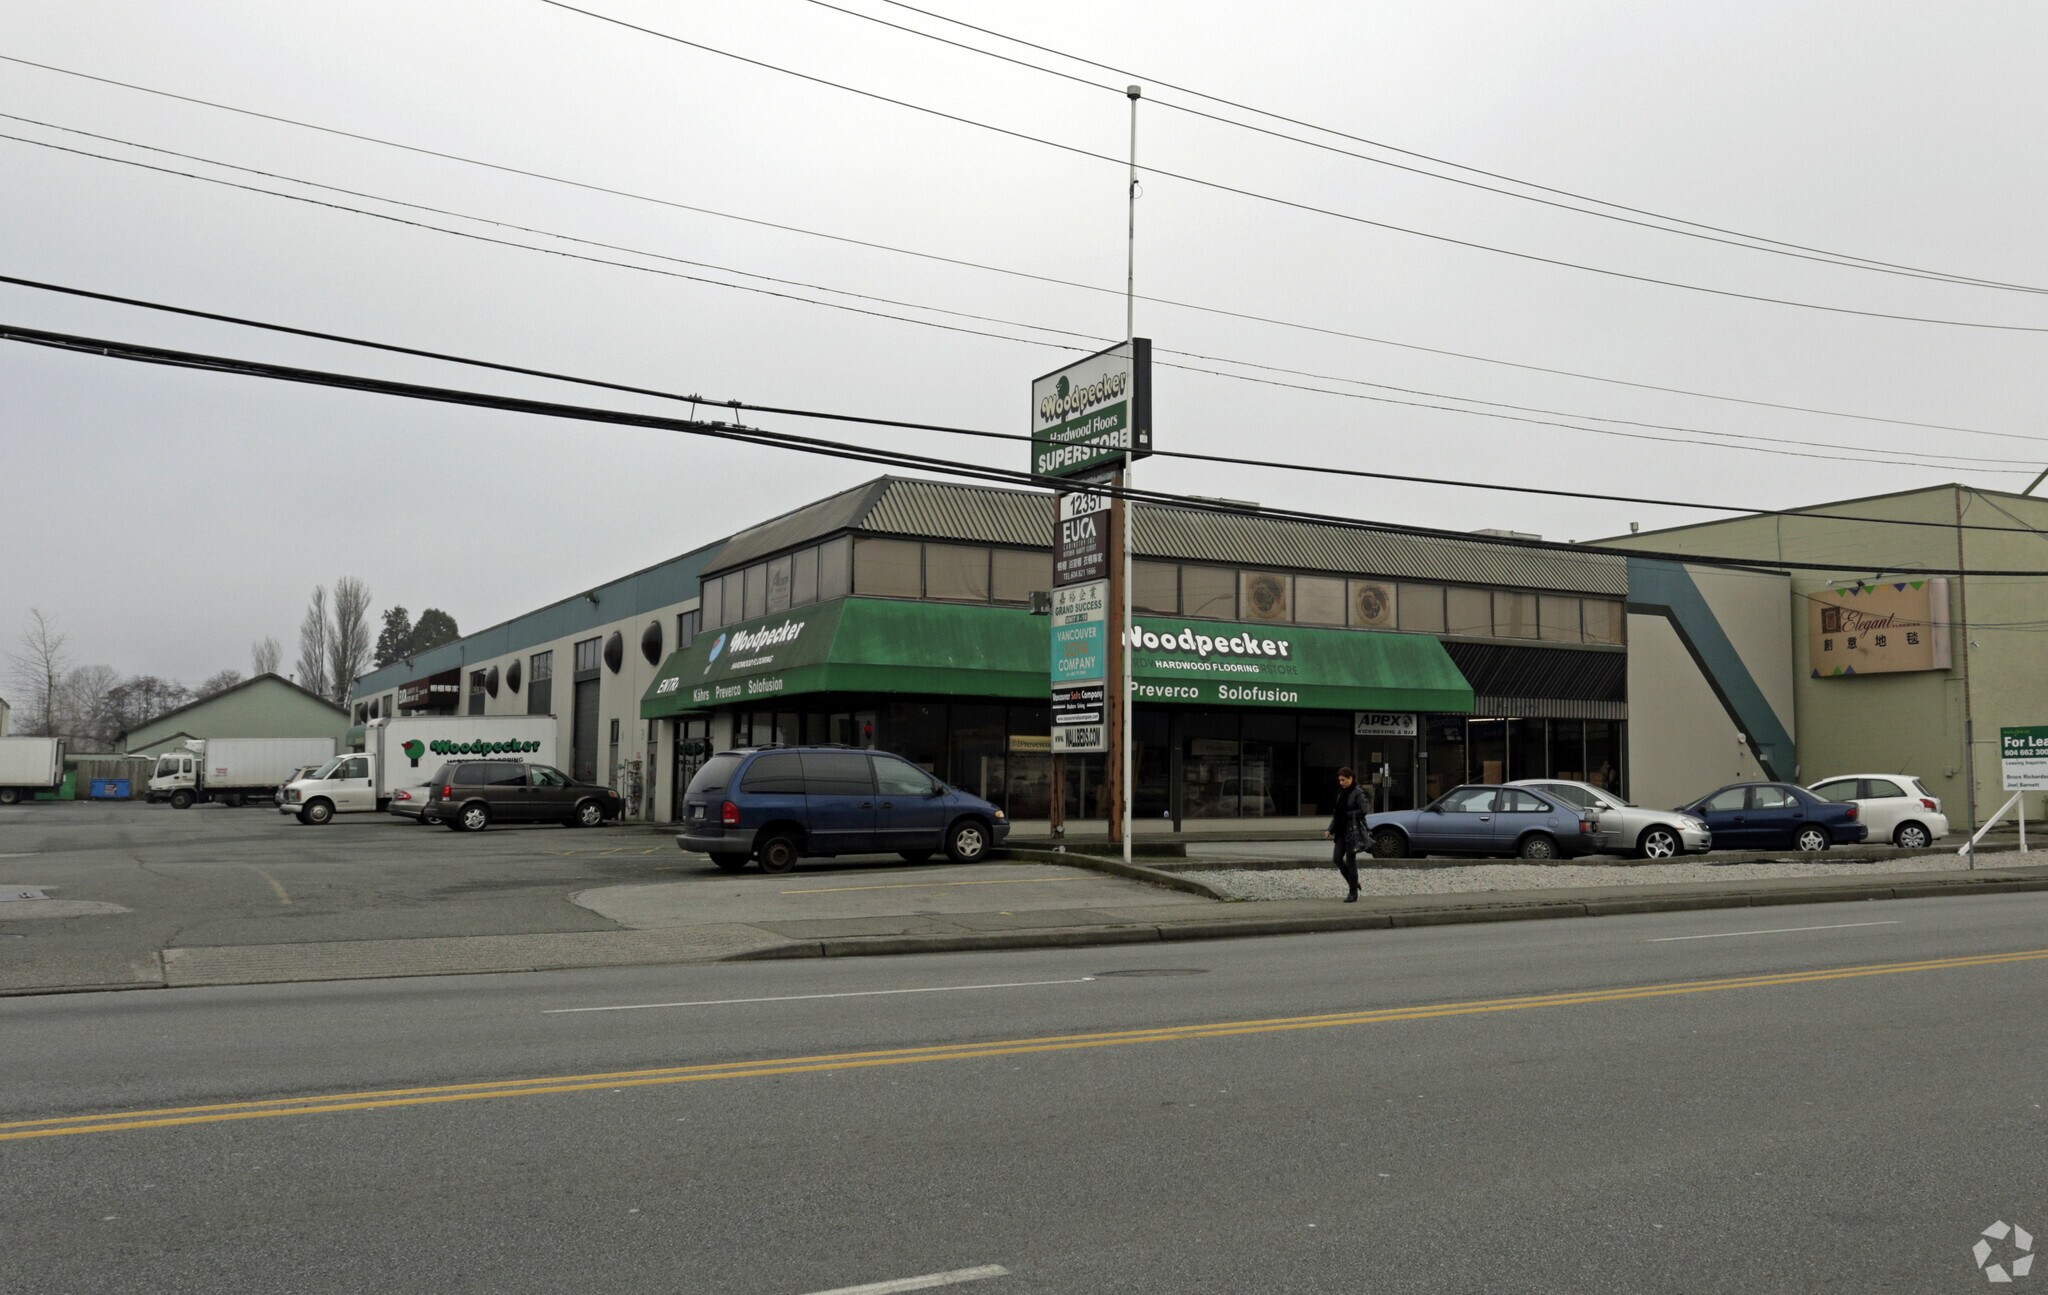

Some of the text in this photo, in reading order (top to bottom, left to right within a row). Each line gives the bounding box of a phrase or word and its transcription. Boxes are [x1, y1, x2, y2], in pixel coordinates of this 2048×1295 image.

[1041, 372, 1127, 423] Woodpecker
[1050, 414, 1118, 447] Hardwood Floors
[1038, 428, 1128, 474] SUPERSTORE
[1063, 516, 1097, 544] EUCA
[1055, 600, 1102, 616] GRAND SUCCESS
[1057, 626, 1097, 642] VANCOUVER
[1841, 610, 1895, 639] Elegant
[730, 620, 805, 653] Woodpecker
[1122, 625, 1289, 657] Woodpecker
[1064, 640, 1088, 658] SOFA
[1058, 656, 1096, 672] COMPANY
[1155, 660, 1211, 671] HARDWOOD
[1212, 664, 1260, 674] FLOORING
[656, 676, 680, 694] ENTR
[693, 678, 783, 702] Kährs Preverco Solofusion
[1218, 685, 1298, 702] Solofusion
[1070, 690, 1081, 700] Sofa
[1082, 690, 1103, 701] Company
[1065, 727, 1100, 748] WALLBEDS.COM
[2004, 736, 2025, 748] For
[430, 738, 540, 757] Woodpecker
